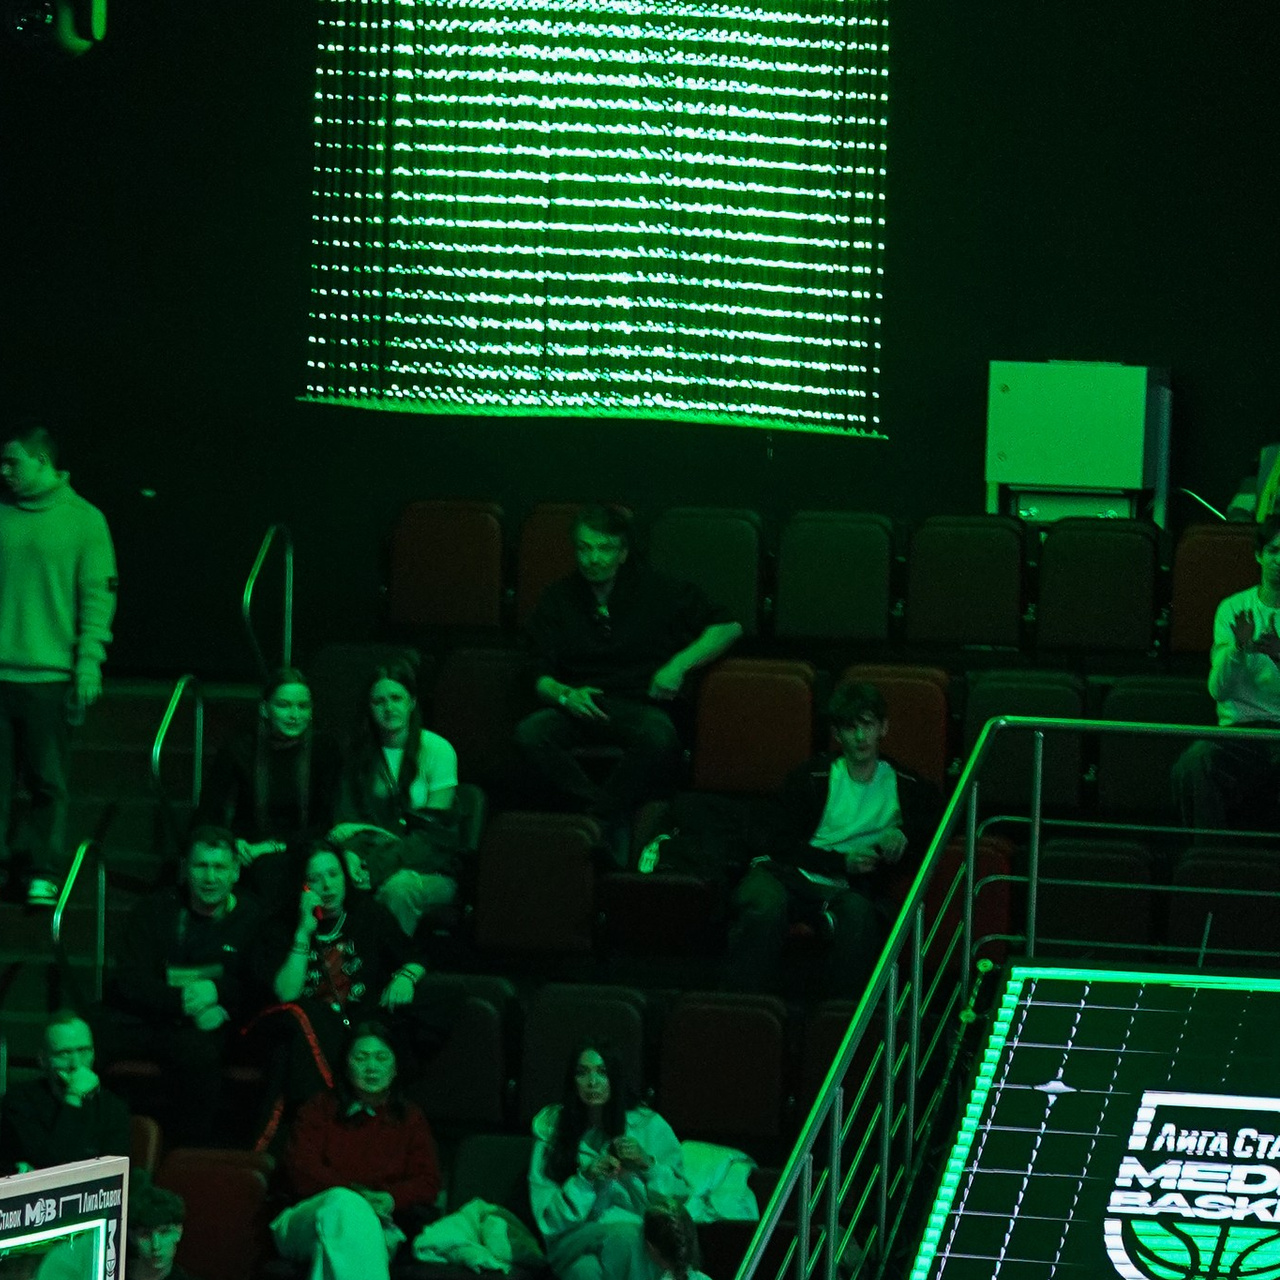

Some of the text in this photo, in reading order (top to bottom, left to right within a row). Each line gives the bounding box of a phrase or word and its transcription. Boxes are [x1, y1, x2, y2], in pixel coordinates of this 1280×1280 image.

[1233, 1128, 1280, 1160] СТА
[1115, 1156, 1280, 1195] MED
[1106, 1189, 1280, 1222] BASK
